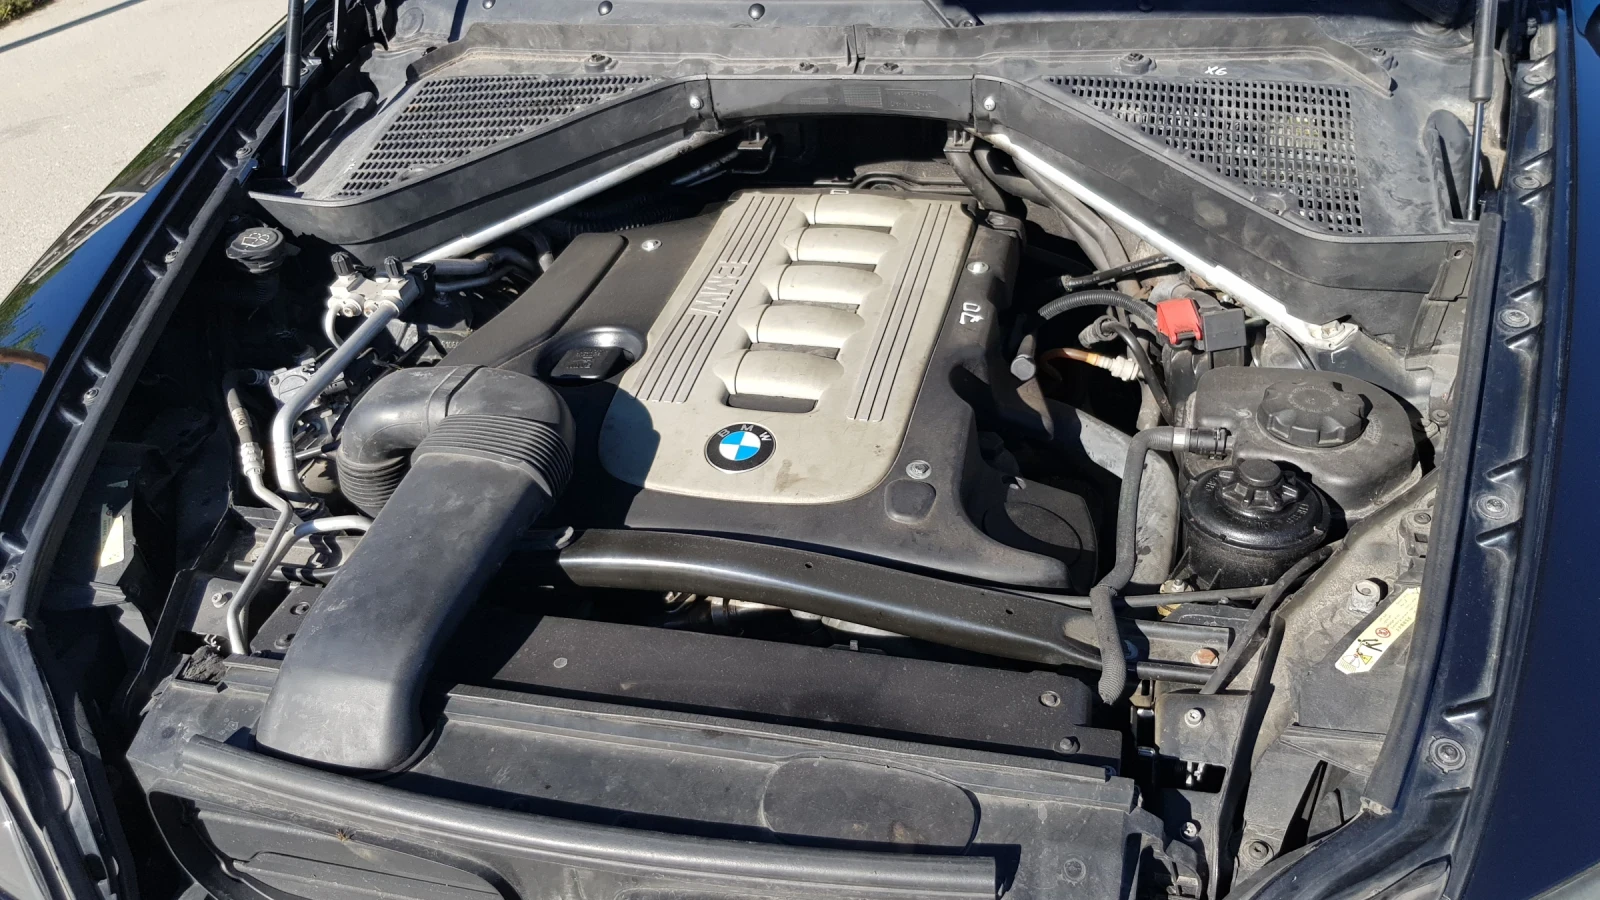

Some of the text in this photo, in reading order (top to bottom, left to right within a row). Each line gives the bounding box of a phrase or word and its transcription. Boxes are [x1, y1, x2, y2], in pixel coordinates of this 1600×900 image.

[1204, 66, 1228, 76] X6
[689, 260, 749, 316] BMW
[717, 424, 772, 441] BMW
